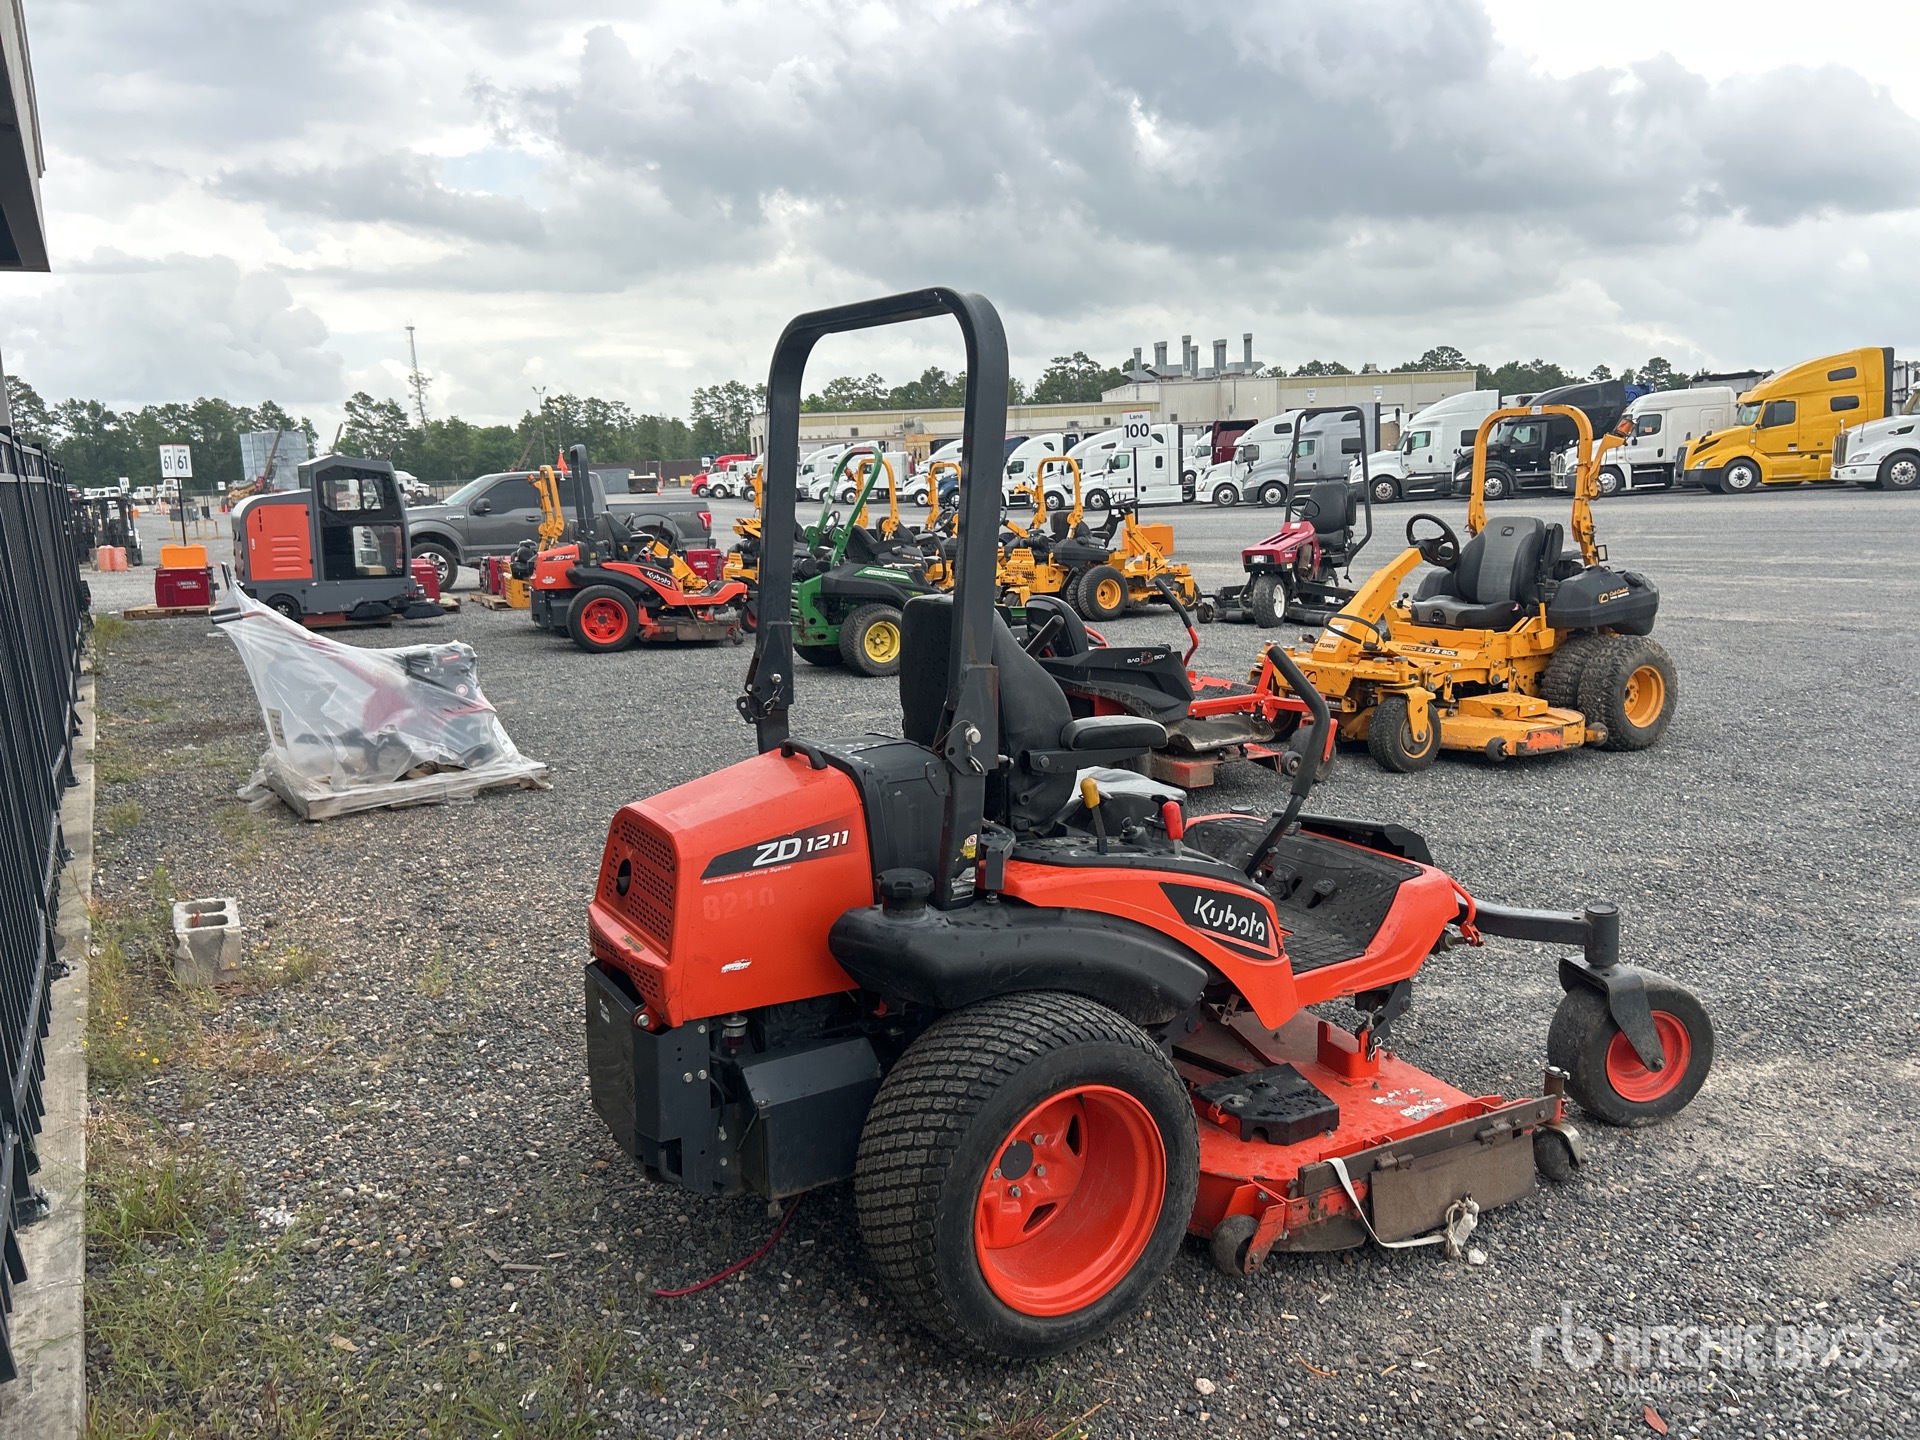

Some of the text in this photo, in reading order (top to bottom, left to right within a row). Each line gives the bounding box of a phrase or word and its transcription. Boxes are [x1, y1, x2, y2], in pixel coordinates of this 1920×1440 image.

[1124, 423, 1149, 438] 100
[164, 455, 172, 469] 61
[178, 455, 188, 470] 61
[646, 571, 671, 586] Kubota
[752, 830, 849, 867] ZD 1211
[702, 873, 743, 885] Aerodynamic
[744, 869, 768, 878] Cutting
[1193, 895, 1265, 941] Kubota
